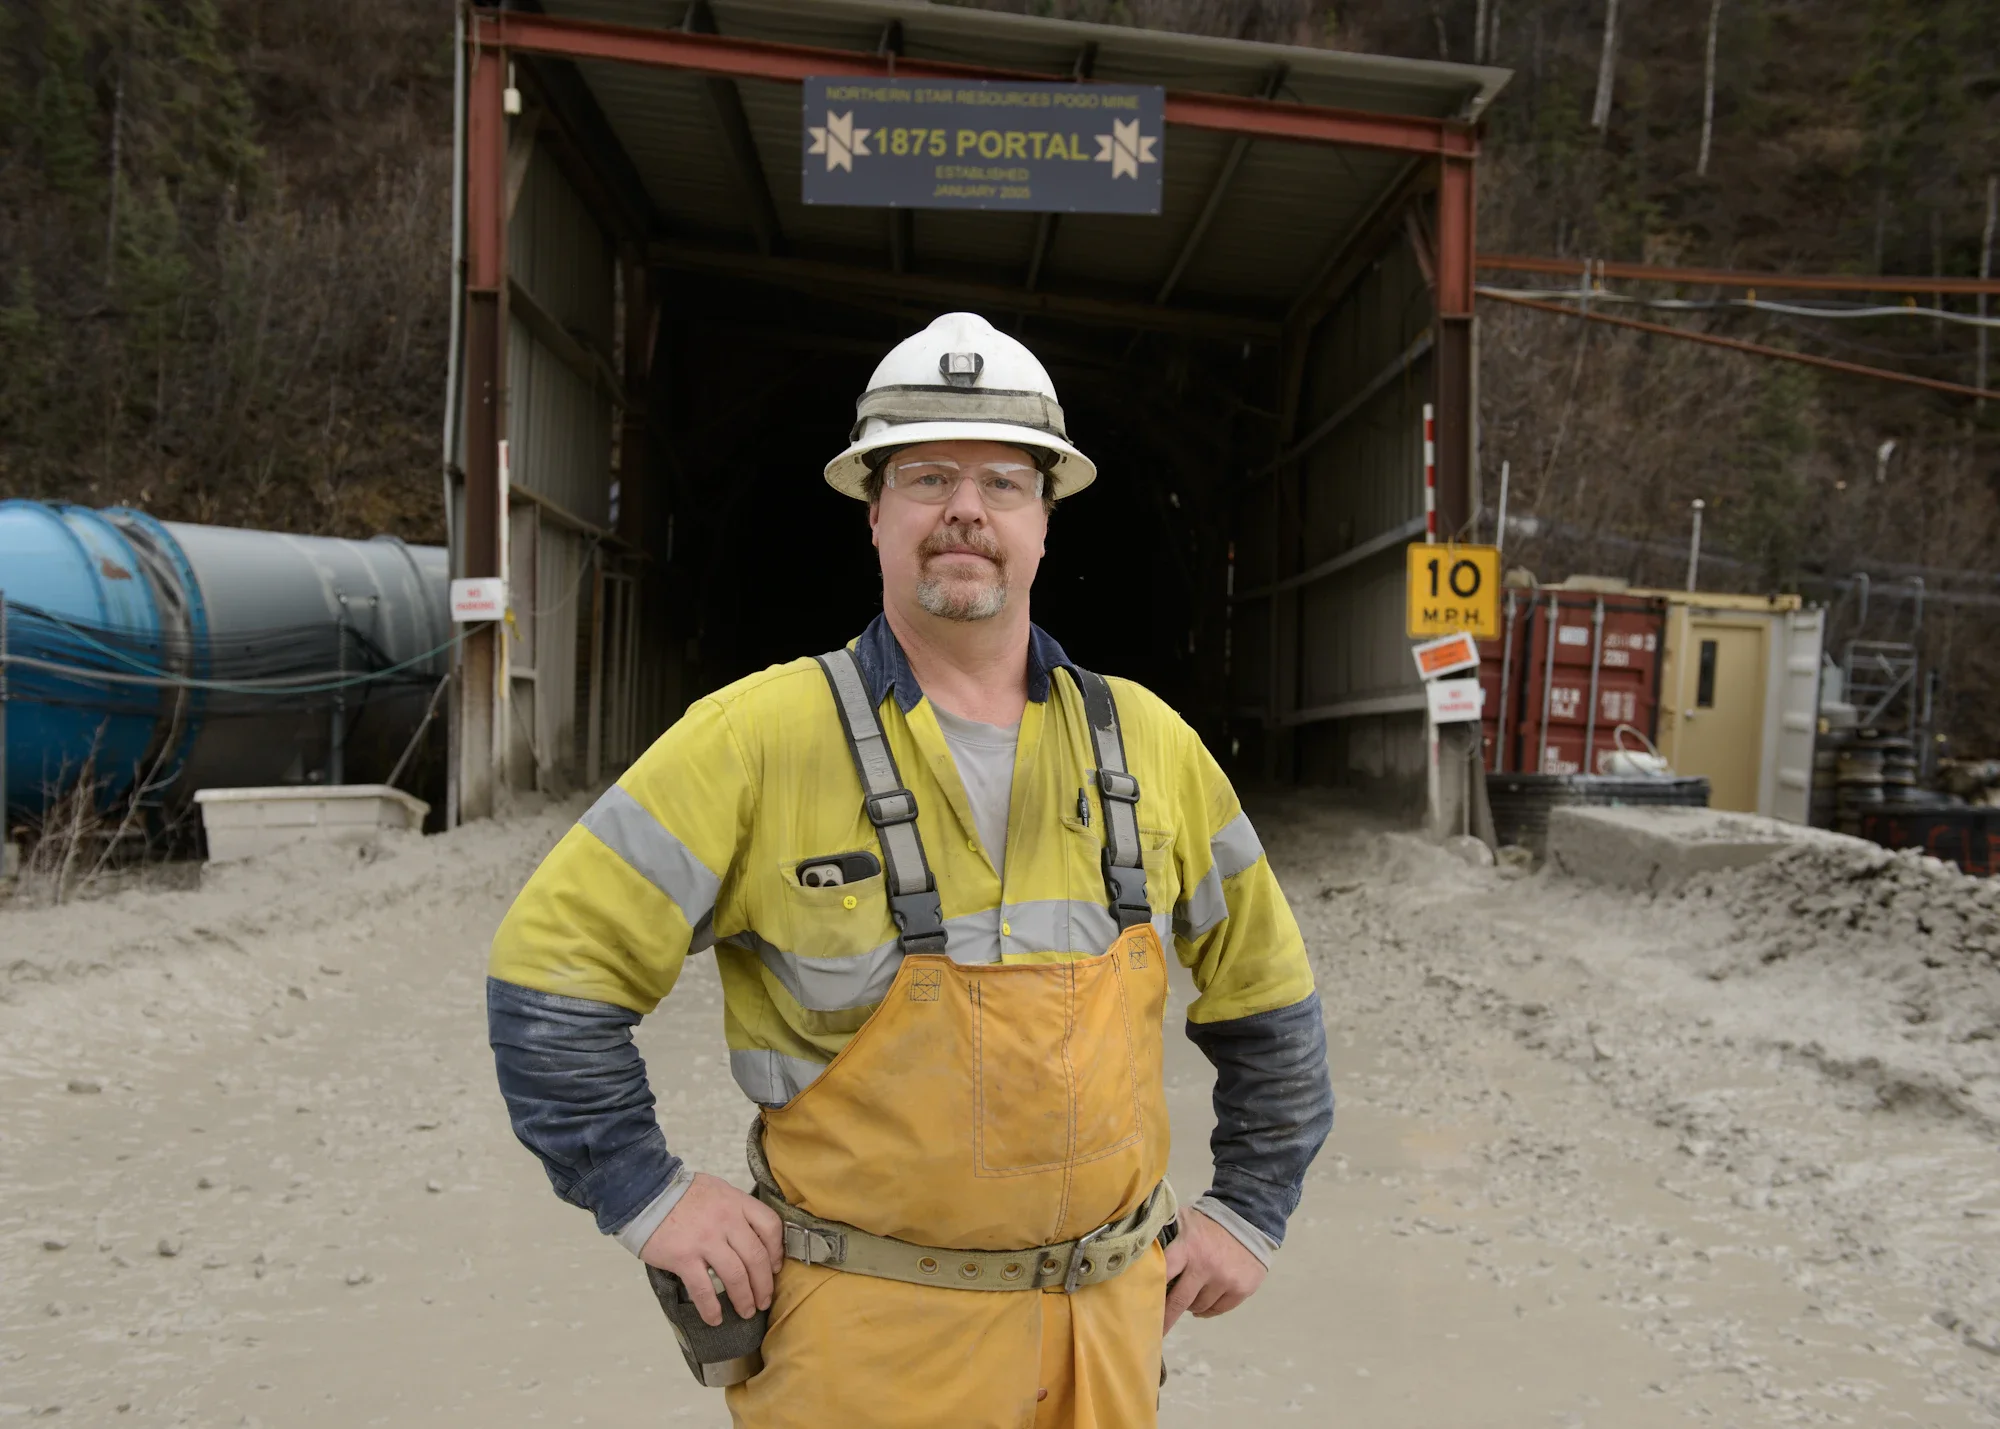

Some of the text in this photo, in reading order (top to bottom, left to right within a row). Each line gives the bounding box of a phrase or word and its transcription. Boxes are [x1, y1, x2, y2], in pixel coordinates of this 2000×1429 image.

[826, 86, 1139, 109] NORTHERN STAR RESOURCES POGO MINE
[873, 127, 1090, 160] 1875 PORTAL
[935, 165, 1029, 181] ESTABLISHED
[933, 184, 996, 197] JANUARY
[1428, 559, 1481, 598] 10
